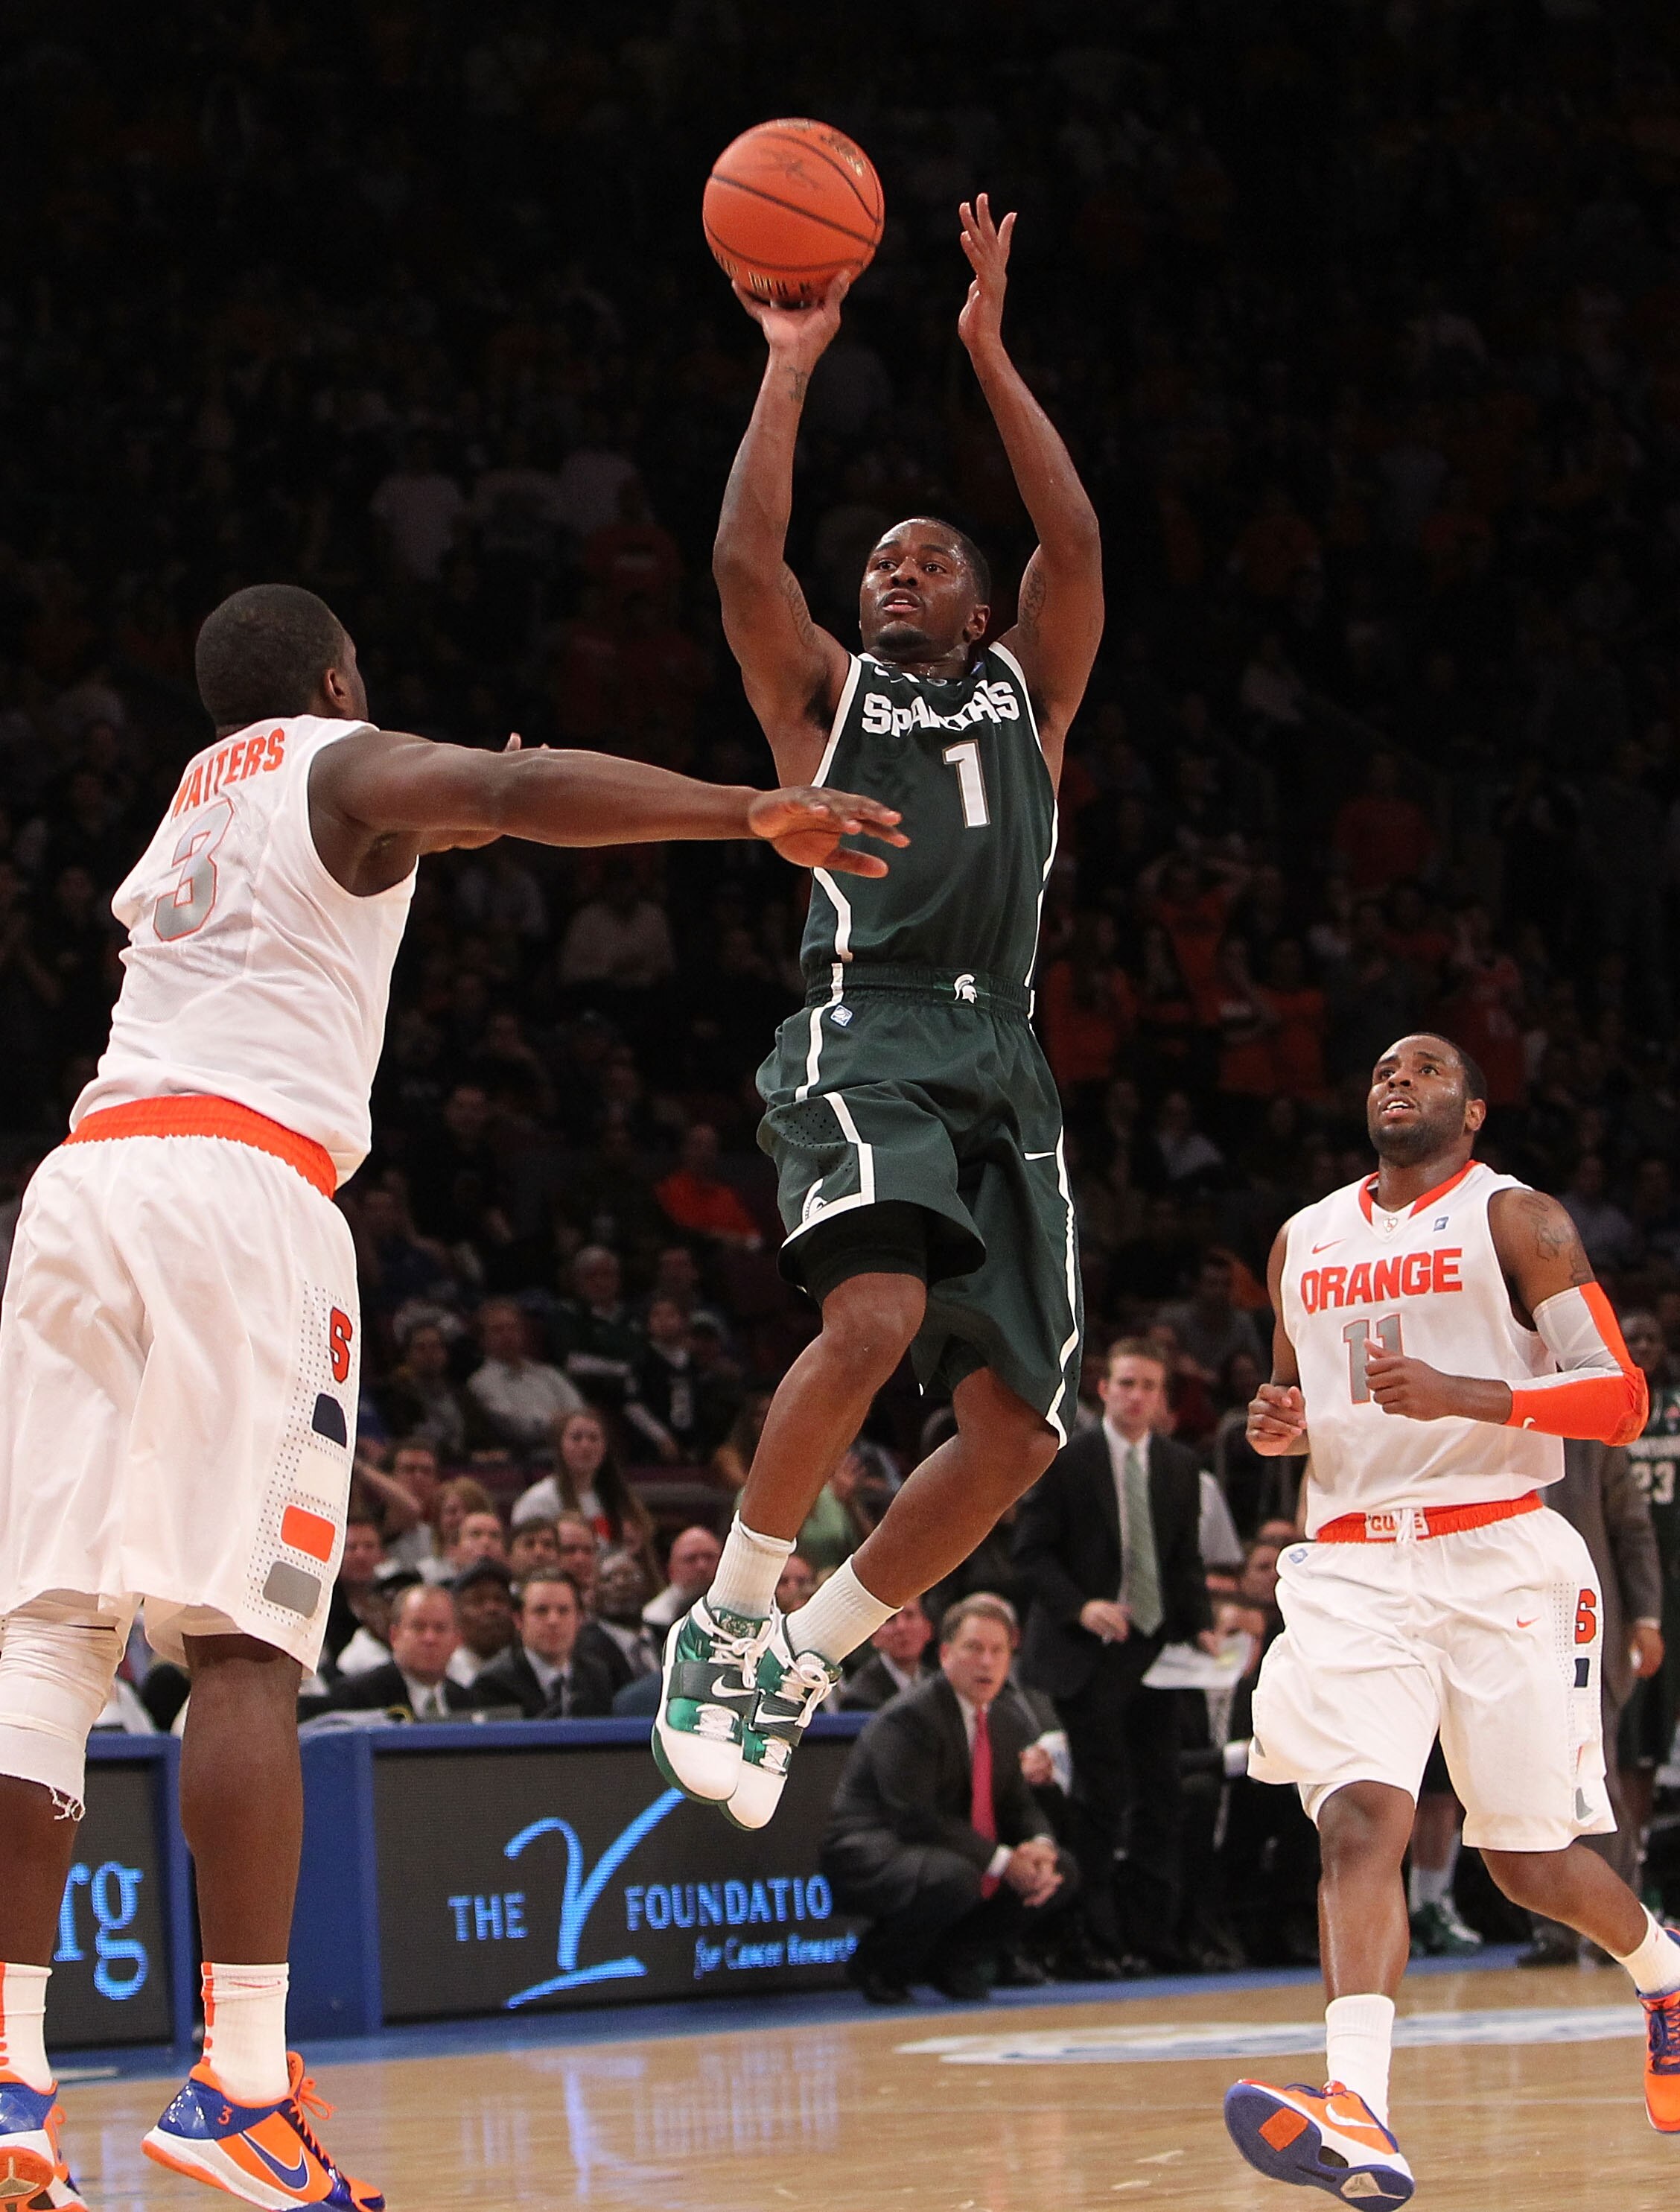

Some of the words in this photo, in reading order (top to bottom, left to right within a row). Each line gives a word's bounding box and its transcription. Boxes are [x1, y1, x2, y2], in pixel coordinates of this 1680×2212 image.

[942, 739, 990, 829] 1
[153, 797, 235, 942] 3
[1300, 1247, 1463, 1315] ORANGE
[329, 1306, 353, 1384] S
[1368, 1513, 1423, 1531] 'CUE
[1574, 1588, 1597, 1644] S
[54, 1861, 148, 2000] rg
[447, 1891, 529, 1942] THE
[624, 1874, 833, 1930] FOUNDATIO
[218, 2105, 233, 2125] 3
